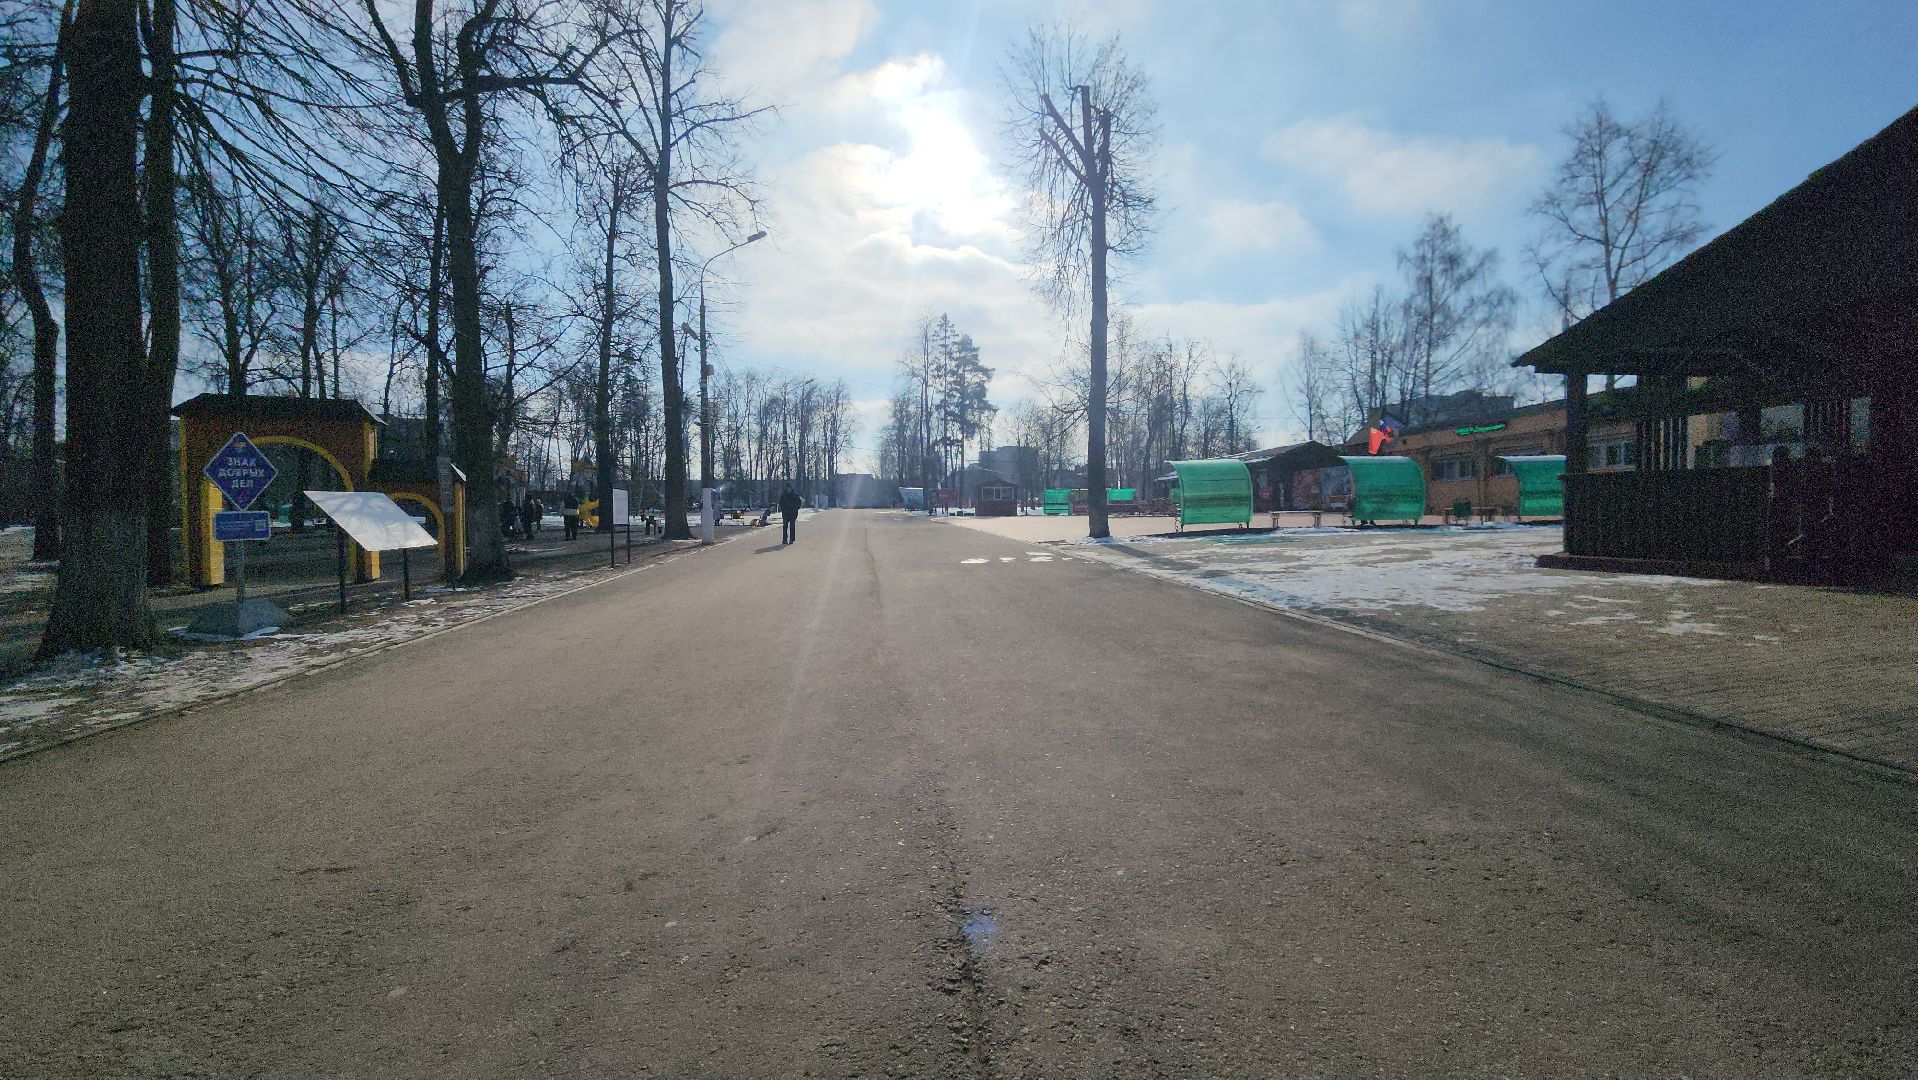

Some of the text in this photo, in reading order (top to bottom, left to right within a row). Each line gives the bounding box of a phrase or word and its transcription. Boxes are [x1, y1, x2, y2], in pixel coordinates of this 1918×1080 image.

[227, 457, 256, 467] ЗНАК
[218, 468, 265, 478] ДОБРЫХ
[231, 480, 254, 489] ДЕЛ
